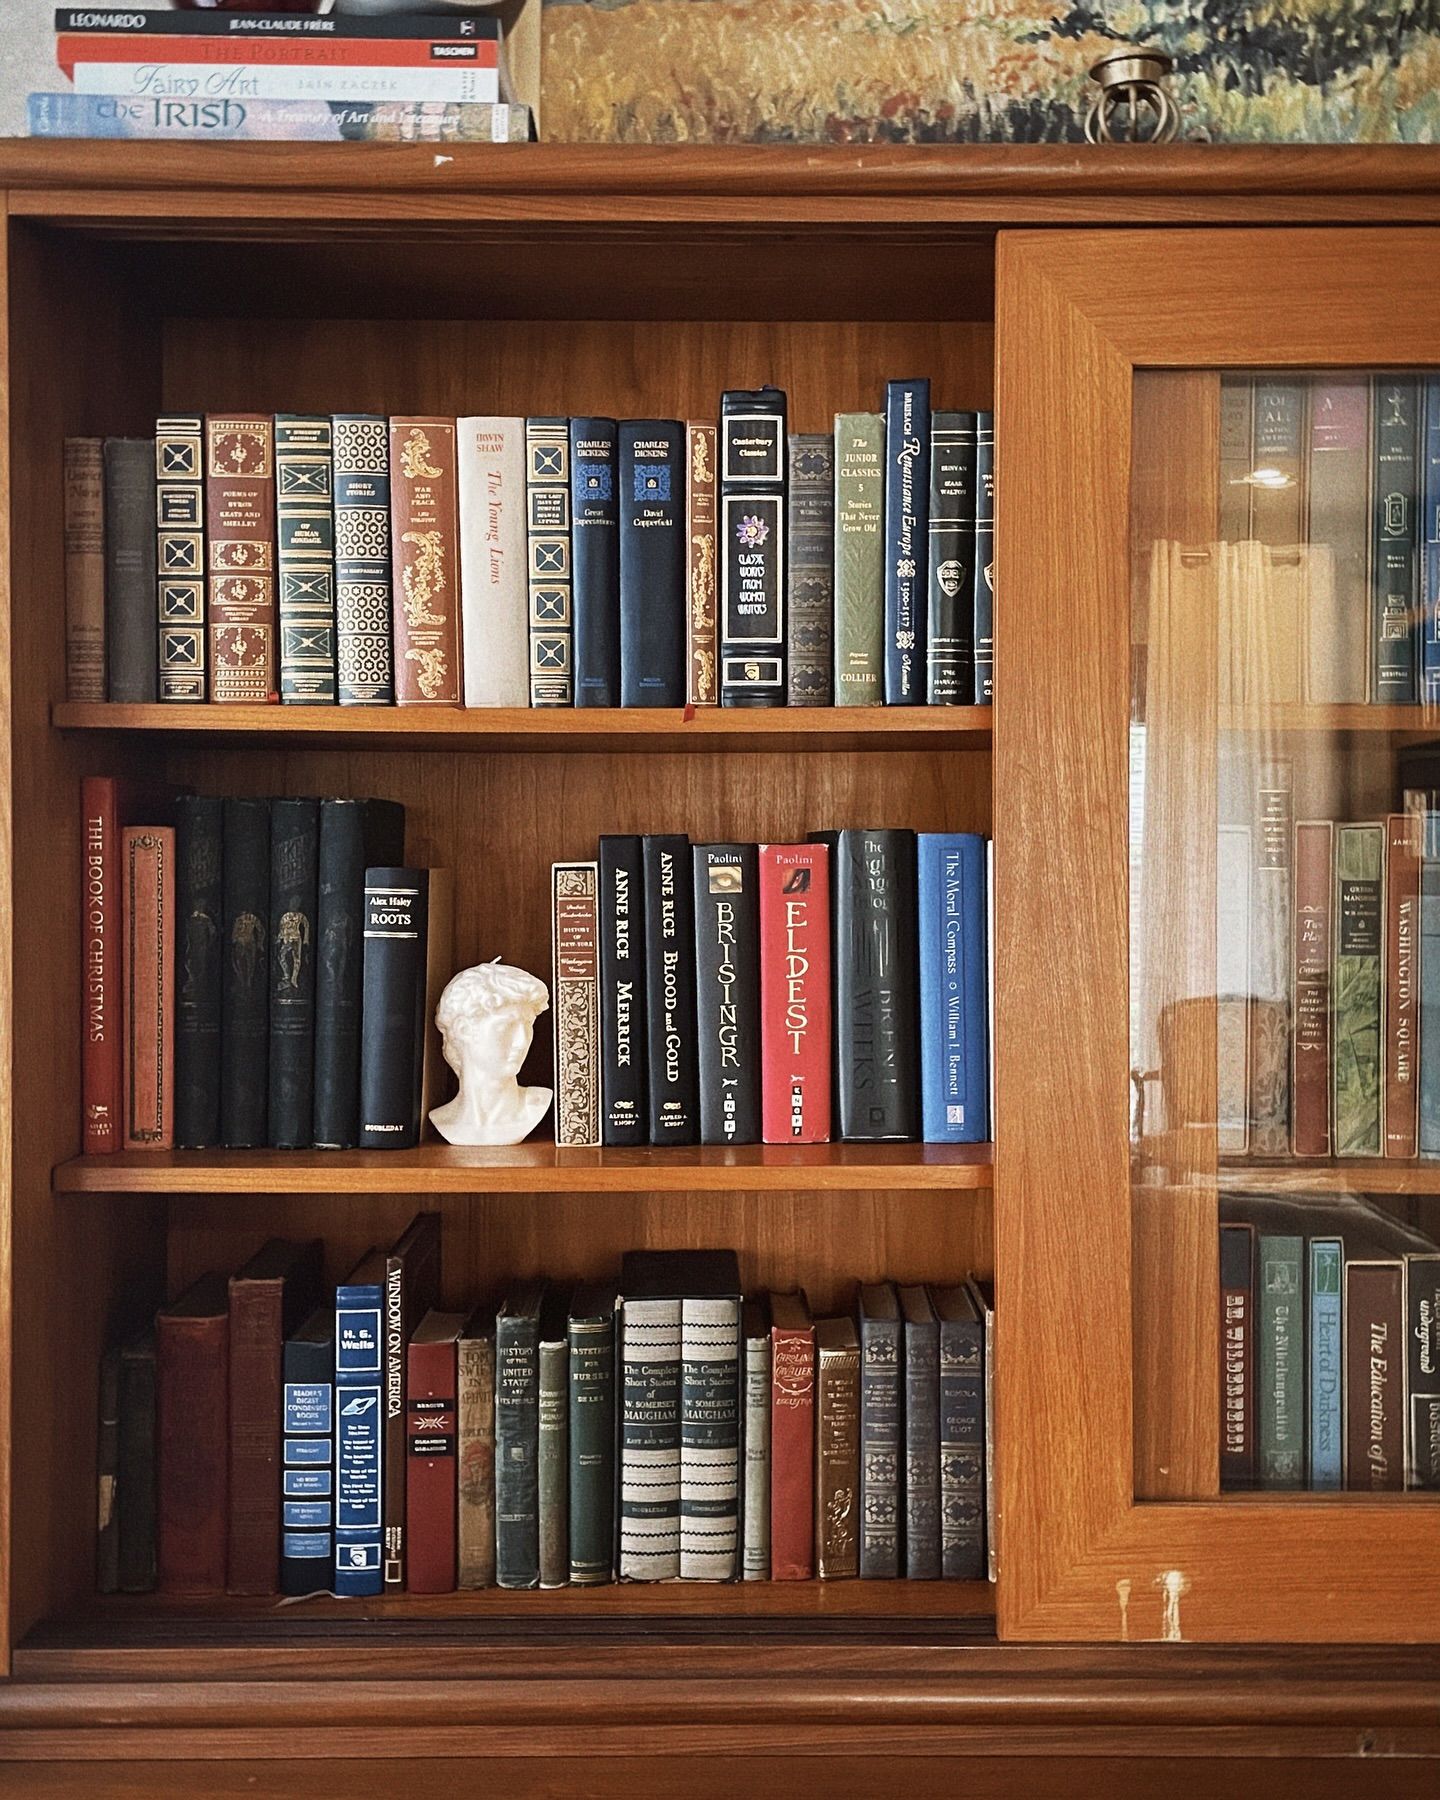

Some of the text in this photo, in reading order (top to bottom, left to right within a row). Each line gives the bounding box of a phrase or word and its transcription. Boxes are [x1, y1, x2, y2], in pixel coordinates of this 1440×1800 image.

[69, 13, 146, 29] LEONARDO
[229, 18, 302, 31] JEAN-CLAUDE
[202, 46, 347, 62] THE PORTRAIT
[433, 47, 475, 57] TASCHEN
[132, 65, 259, 96] Fairy Art
[339, 79, 397, 90] ZACZEK
[96, 99, 247, 128] the IRISH
[334, 109, 348, 126] of
[348, 110, 370, 123] Art
[371, 110, 395, 123] and
[476, 433, 504, 443] IRWIN
[732, 437, 773, 448] Canterbury
[852, 438, 867, 447] The
[476, 444, 504, 453] SHAW
[576, 440, 612, 449] CHARLES
[633, 440, 669, 449] CHARLES
[577, 449, 611, 459] DICKENS
[634, 449, 668, 459] DICKENS
[739, 447, 768, 457] Classics
[844, 453, 878, 463] JUNIOR
[840, 467, 881, 478] CLASSICS
[897, 392, 920, 556] BREISACH Renaissance Europe
[847, 500, 872, 509] Stories
[583, 508, 605, 518] Great
[643, 508, 663, 518] David
[839, 512, 880, 521] That Never
[484, 470, 504, 585] The Young Lions
[633, 517, 673, 529] Copperfield
[842, 524, 877, 533] Grow Old
[742, 579, 763, 590] FROM
[840, 673, 877, 683] COLLIER
[708, 853, 743, 864] Paolini
[776, 854, 813, 865] Paolini
[369, 896, 413, 908] Alex Haley
[370, 913, 412, 926] ROOTS
[88, 816, 104, 1042] THE BOOK OF CHRISTMAS
[615, 868, 633, 1068] ANNE RICE MERRICK
[661, 851, 681, 1083] ANNE RICE BLOOD and GOLD
[785, 902, 809, 1055] ELDEST
[944, 852, 962, 1096] The Moral Compass William Bennett
[717, 902, 741, 1068] BRISINGR
[1396, 902, 1412, 1084] WASHINGTON SQUARE
[364, 1124, 404, 1132] DOUBLEDAY
[1273, 1306, 1290, 1332] The
[344, 1330, 372, 1338] H. G.
[1371, 1322, 1387, 1354] The
[1414, 1299, 1435, 1375] underground
[341, 1338, 375, 1350] Wells
[386, 1269, 403, 1419] WINDOW ON AMERICA
[500, 1347, 534, 1357] HISTORY
[462, 1352, 490, 1364] TOM
[502, 1367, 534, 1377] UNITED
[624, 1364, 679, 1379] The Complete
[683, 1363, 698, 1375] The
[624, 1376, 647, 1387] Short
[684, 1375, 707, 1387] Short
[1319, 1310, 1338, 1452] Heart of Darkness
[646, 1389, 656, 1399] of
[705, 1389, 716, 1398] of
[945, 1389, 978, 1398] ROMOLA
[1225, 1326, 1244, 1454] WILDERNESS!
[684, 1399, 735, 1408] W. SOMERSET
[1370, 1356, 1387, 1441] Education
[624, 1400, 678, 1409] W. SOMERSET
[623, 1410, 677, 1421] MAUGHAM
[683, 1408, 736, 1421] MAUGHAM
[946, 1417, 977, 1425] GEORGE
[950, 1425, 972, 1434] ELIOT
[1366, 1444, 1386, 1463] of
